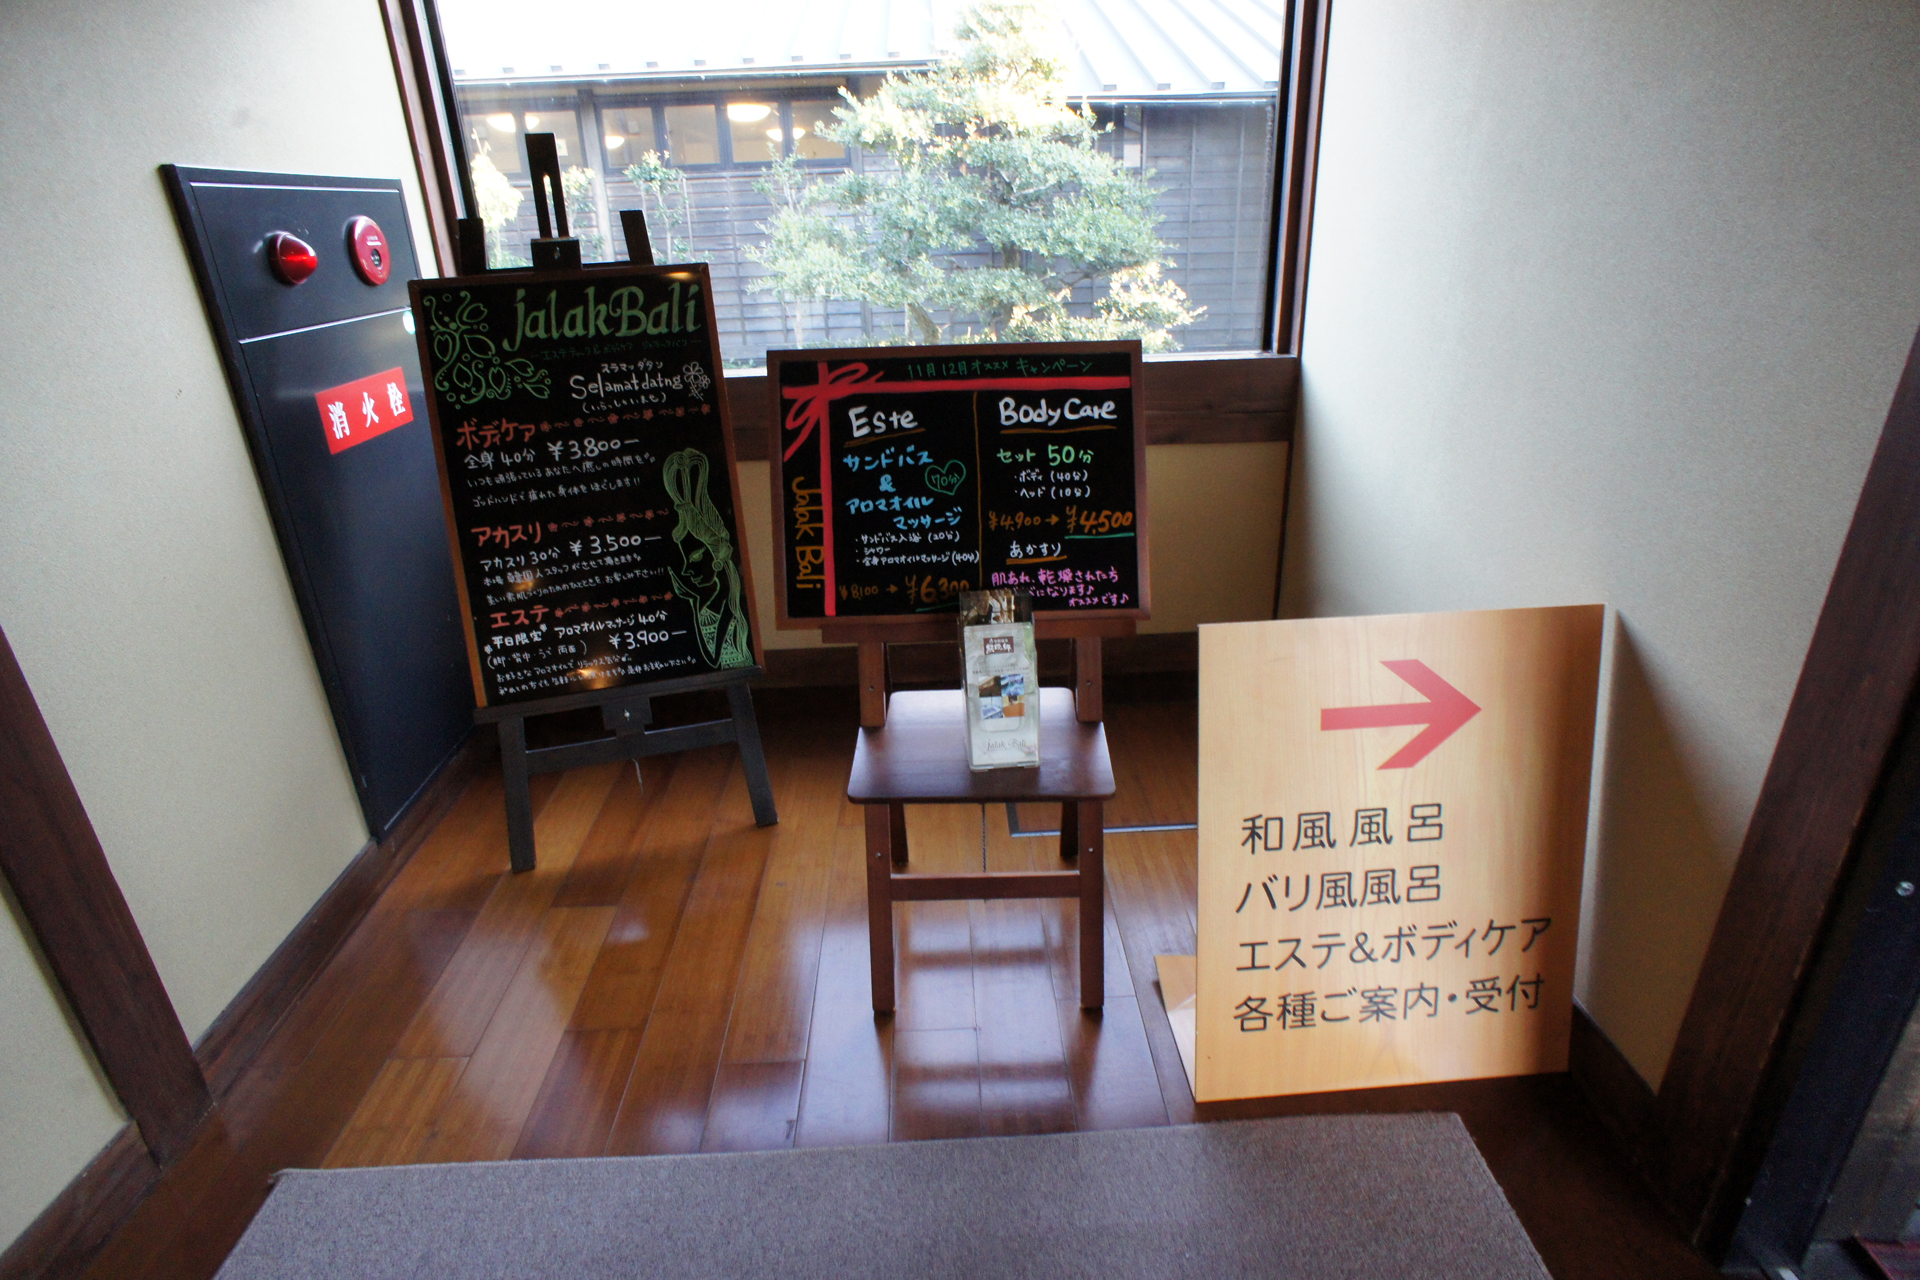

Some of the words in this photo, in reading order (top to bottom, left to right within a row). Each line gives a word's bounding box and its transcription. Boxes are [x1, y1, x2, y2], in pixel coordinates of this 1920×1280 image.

[327, 382, 406, 440] 消火栓
[849, 405, 918, 438] Este
[456, 416, 535, 450] ボディケア
[842, 445, 934, 472] サンドバス
[879, 474, 897, 493] &
[845, 495, 935, 515] アロマオイル
[892, 506, 963, 530] マッサージ
[471, 521, 541, 549] アカスリ
[1009, 540, 1062, 559] あかすり
[795, 546, 826, 589] Bali
[490, 605, 550, 629] エステ
[1241, 803, 1444, 855] 和風風呂
[1236, 864, 1441, 914] バリ風風呂
[1236, 917, 1553, 972] エステ&ボディケア
[1233, 972, 1546, 1033] 各種ご案内・受付
